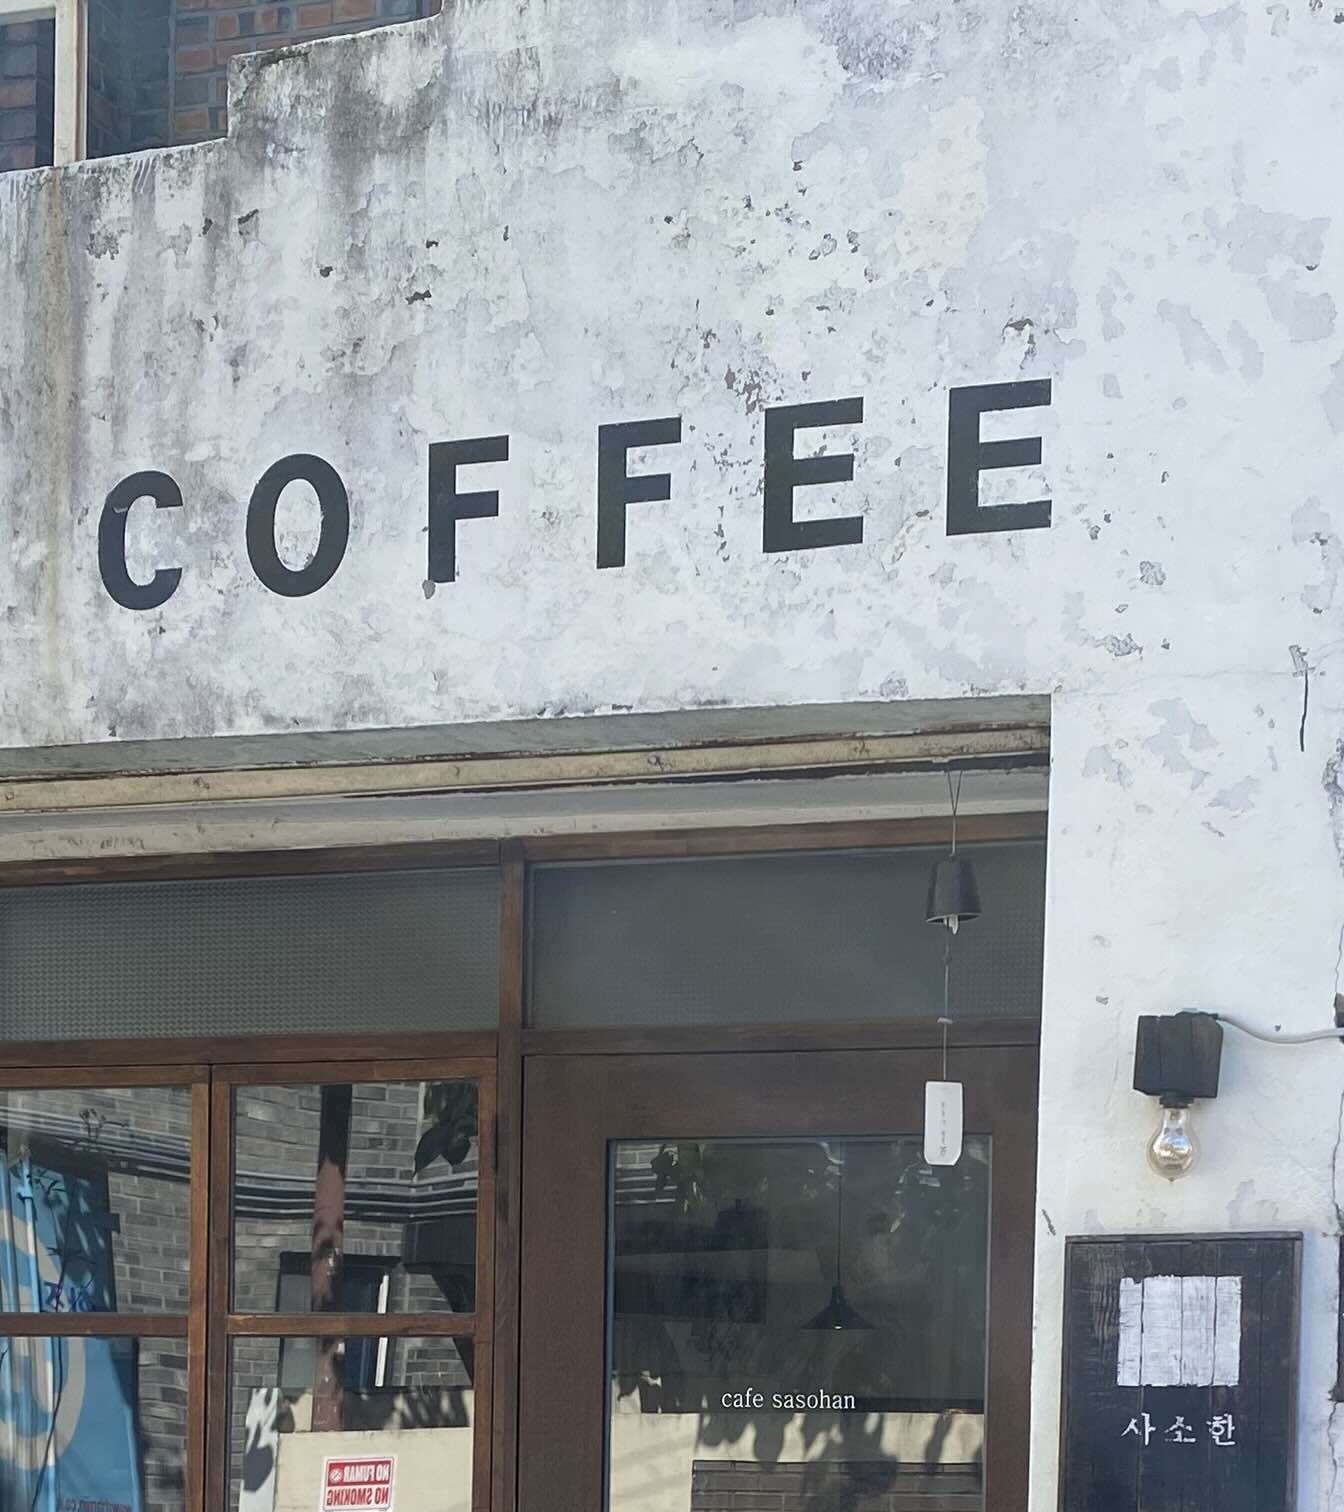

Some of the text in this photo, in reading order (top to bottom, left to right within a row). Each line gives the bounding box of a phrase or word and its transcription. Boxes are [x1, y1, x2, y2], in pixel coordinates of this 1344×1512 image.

[97, 378, 1052, 611] COFFEE
[721, 1387, 856, 1410] cafe sasohan
[1121, 1413, 1236, 1446] 사소한
